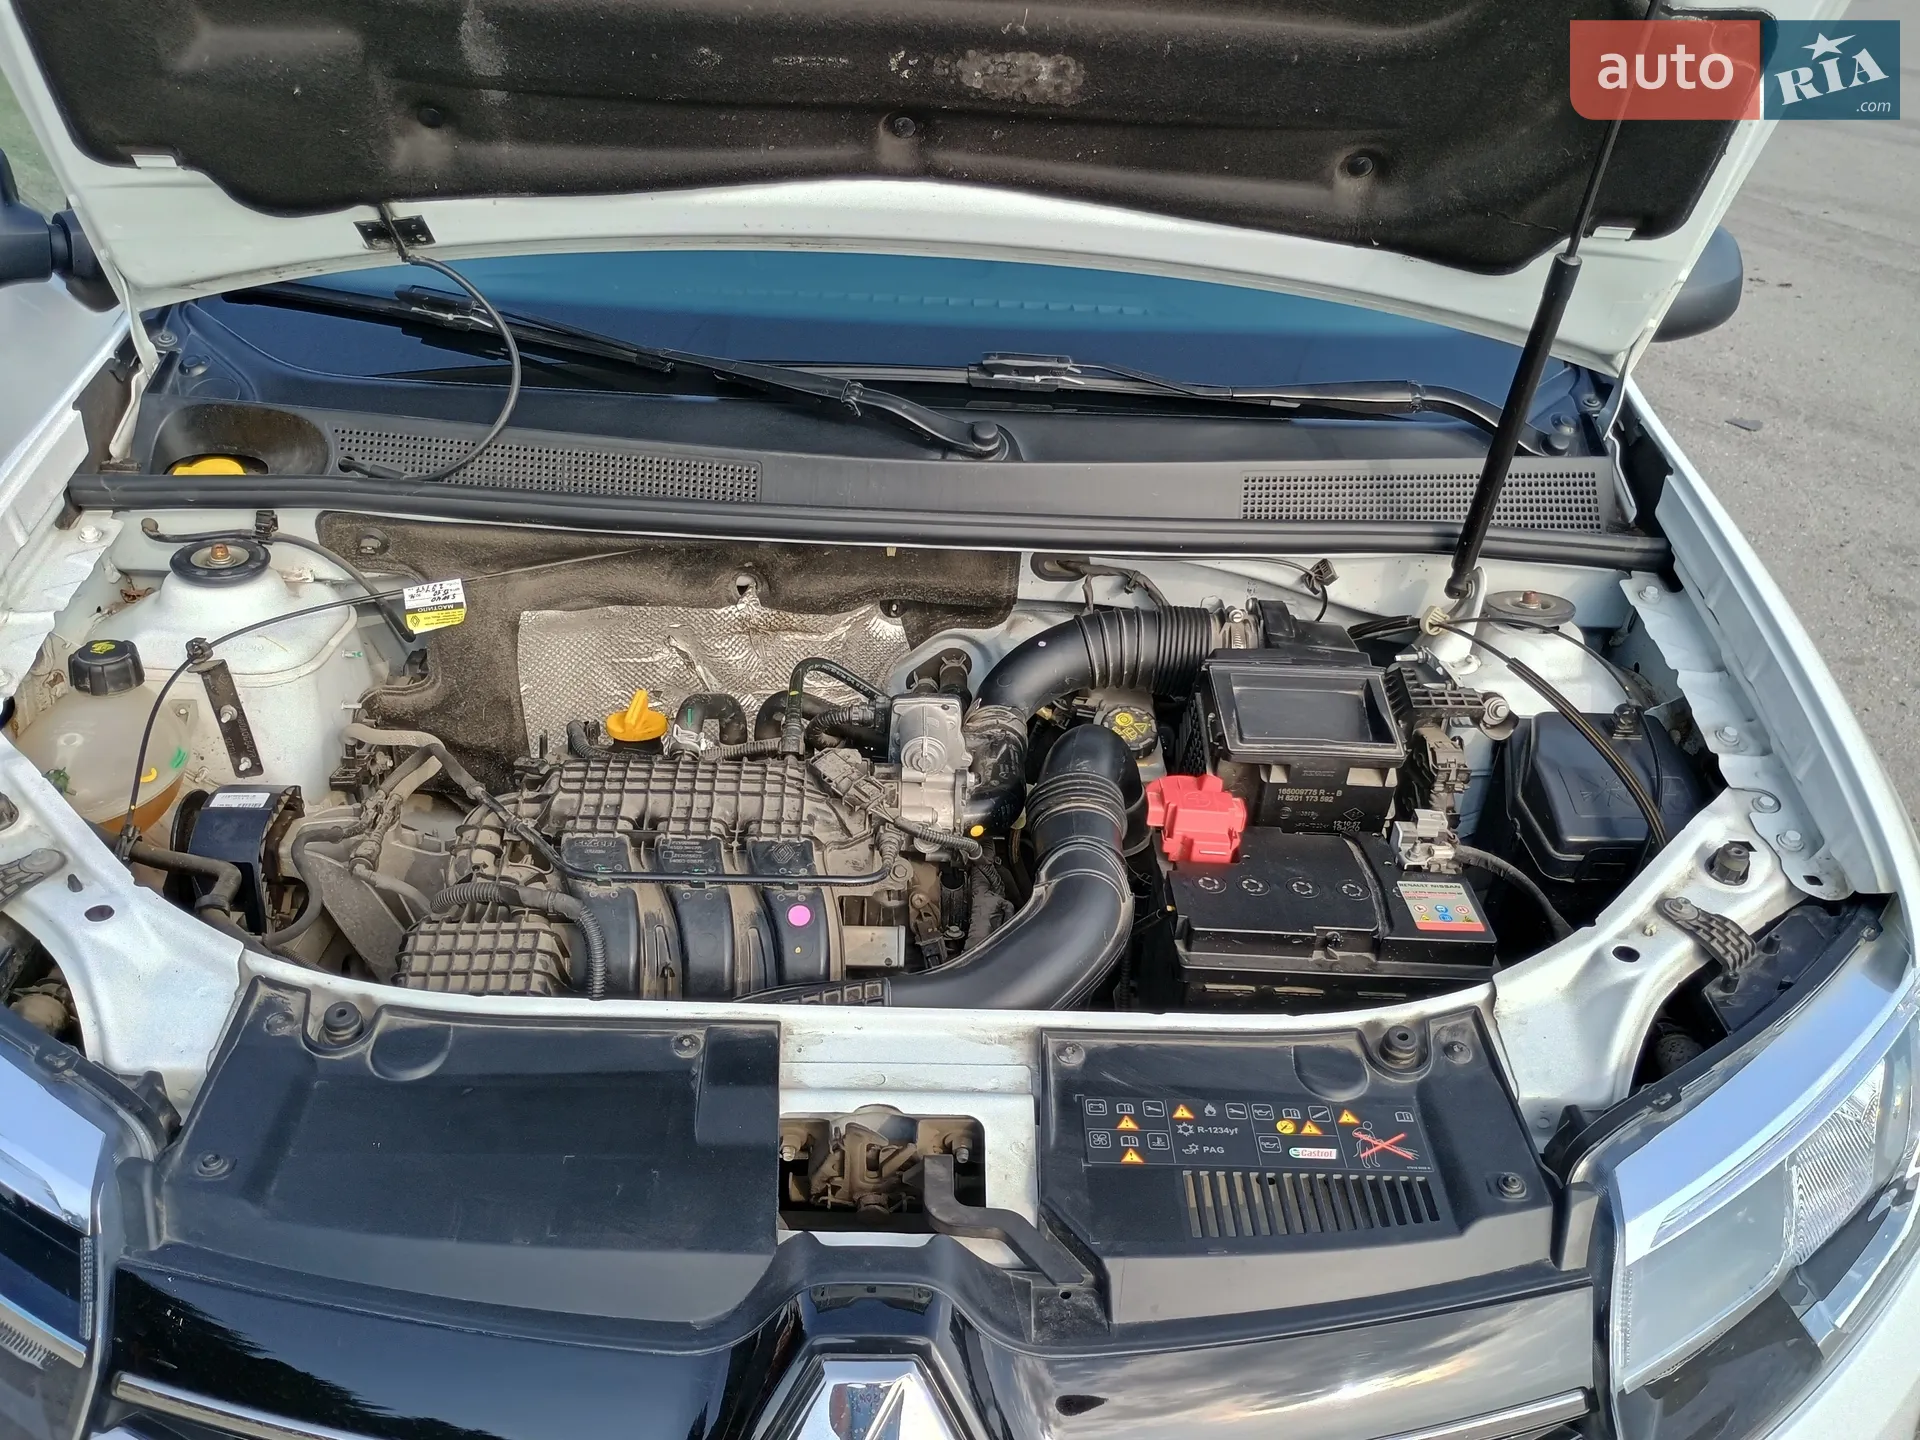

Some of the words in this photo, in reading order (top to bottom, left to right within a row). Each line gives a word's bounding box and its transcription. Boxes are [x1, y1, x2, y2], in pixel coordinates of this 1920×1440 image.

[417, 604, 454, 612] МАСТИЛО
[1197, 1126, 1239, 1136] R-1234yf
[1203, 1146, 1225, 1154] PAG
[1301, 1149, 1333, 1158] Castrol
